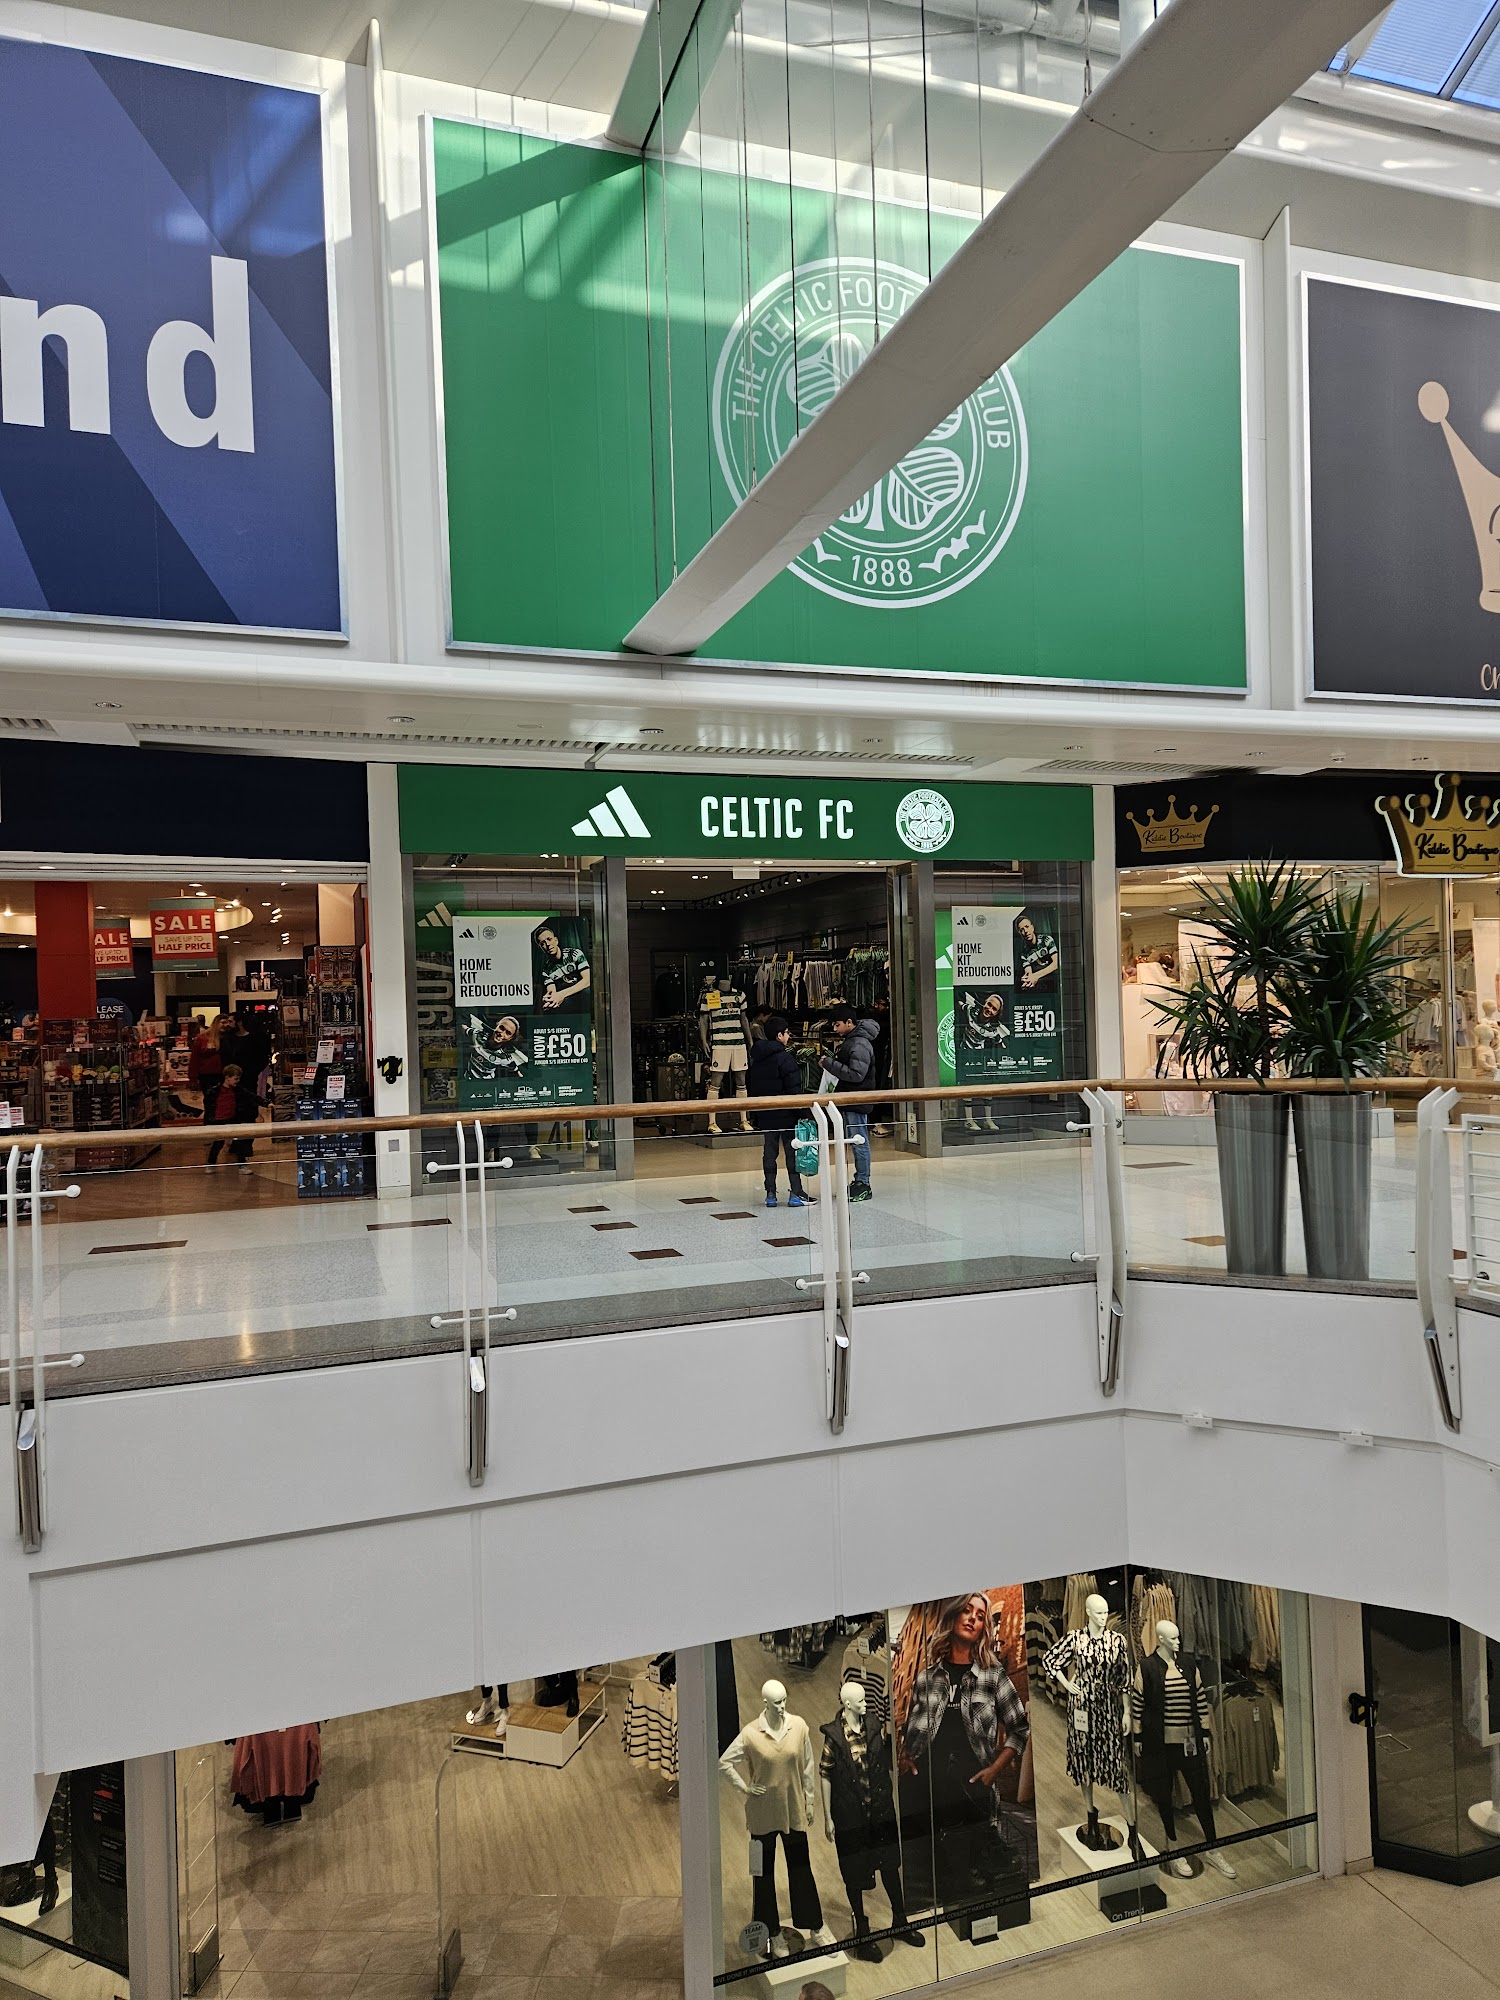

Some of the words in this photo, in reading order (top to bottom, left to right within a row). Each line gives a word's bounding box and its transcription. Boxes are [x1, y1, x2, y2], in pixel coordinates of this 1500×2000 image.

[0, 255, 255, 454] nd
[732, 361, 768, 421] THE
[751, 281, 833, 357] CELTIC
[977, 378, 1011, 449] LUB
[852, 554, 914, 586] 1888
[700, 796, 803, 838] CELTIC
[818, 799, 854, 840] FC
[1142, 830, 1167, 844] Kiddie
[1169, 828, 1202, 844] Boutique
[1414, 832, 1450, 859] Kiddie
[1452, 833, 1499, 861] Boutique
[154, 915, 211, 931] SALE
[184, 942, 211, 950] PRICE
[957, 943, 982, 954] HOME
[459, 958, 492, 970] HOME
[957, 954, 970, 965] KIT
[460, 972, 478, 984] KIT
[958, 966, 1012, 977] REDUCTIONS
[461, 984, 530, 997] REDUCTIONS
[1014, 1012, 1023, 1032] NOW
[1024, 1011, 1055, 1031] £50
[534, 1036, 545, 1058] NOW
[547, 1034, 586, 1058] £50
[860, 1930, 887, 1943] GROWING
[888, 1923, 910, 1935] FASHION
[911, 1917, 934, 1929] RETAILER
[1102, 1864, 1126, 1876] GROWING
[1112, 1912, 1123, 1921] On
[1124, 1906, 1145, 1918] Trend
